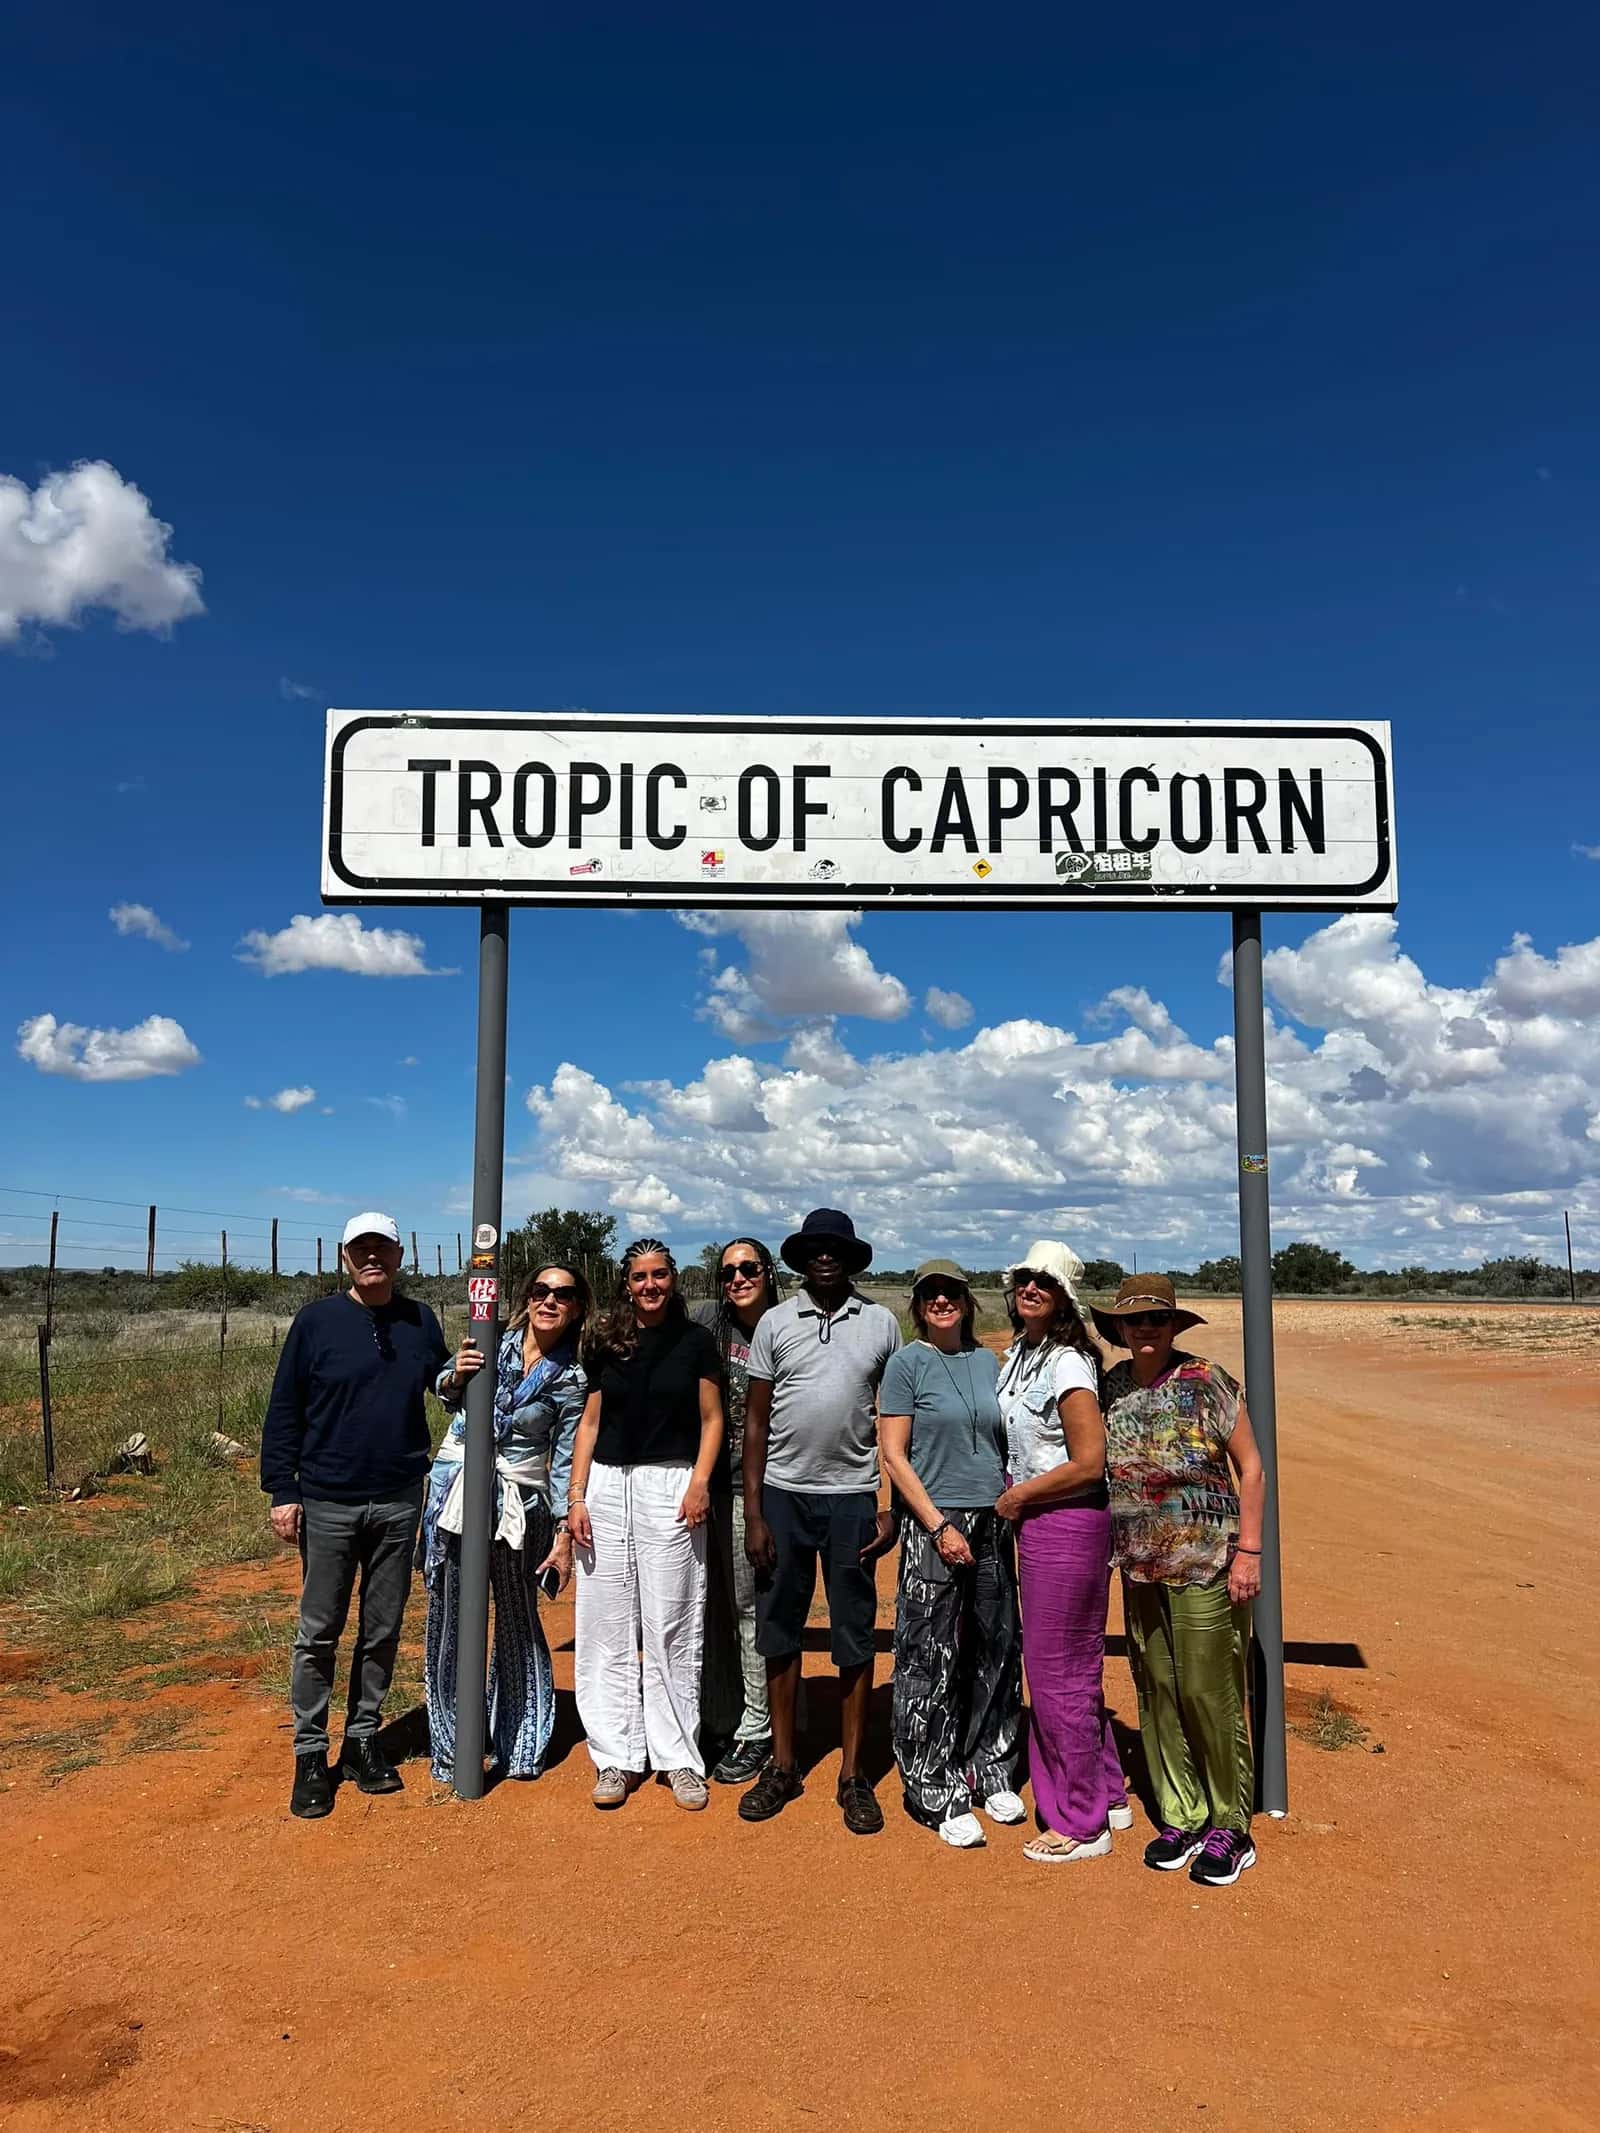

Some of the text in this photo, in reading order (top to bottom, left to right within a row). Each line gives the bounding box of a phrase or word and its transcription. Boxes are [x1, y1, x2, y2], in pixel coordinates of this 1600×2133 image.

[408, 759, 1326, 855] TROPIC OF CAPRICORN
